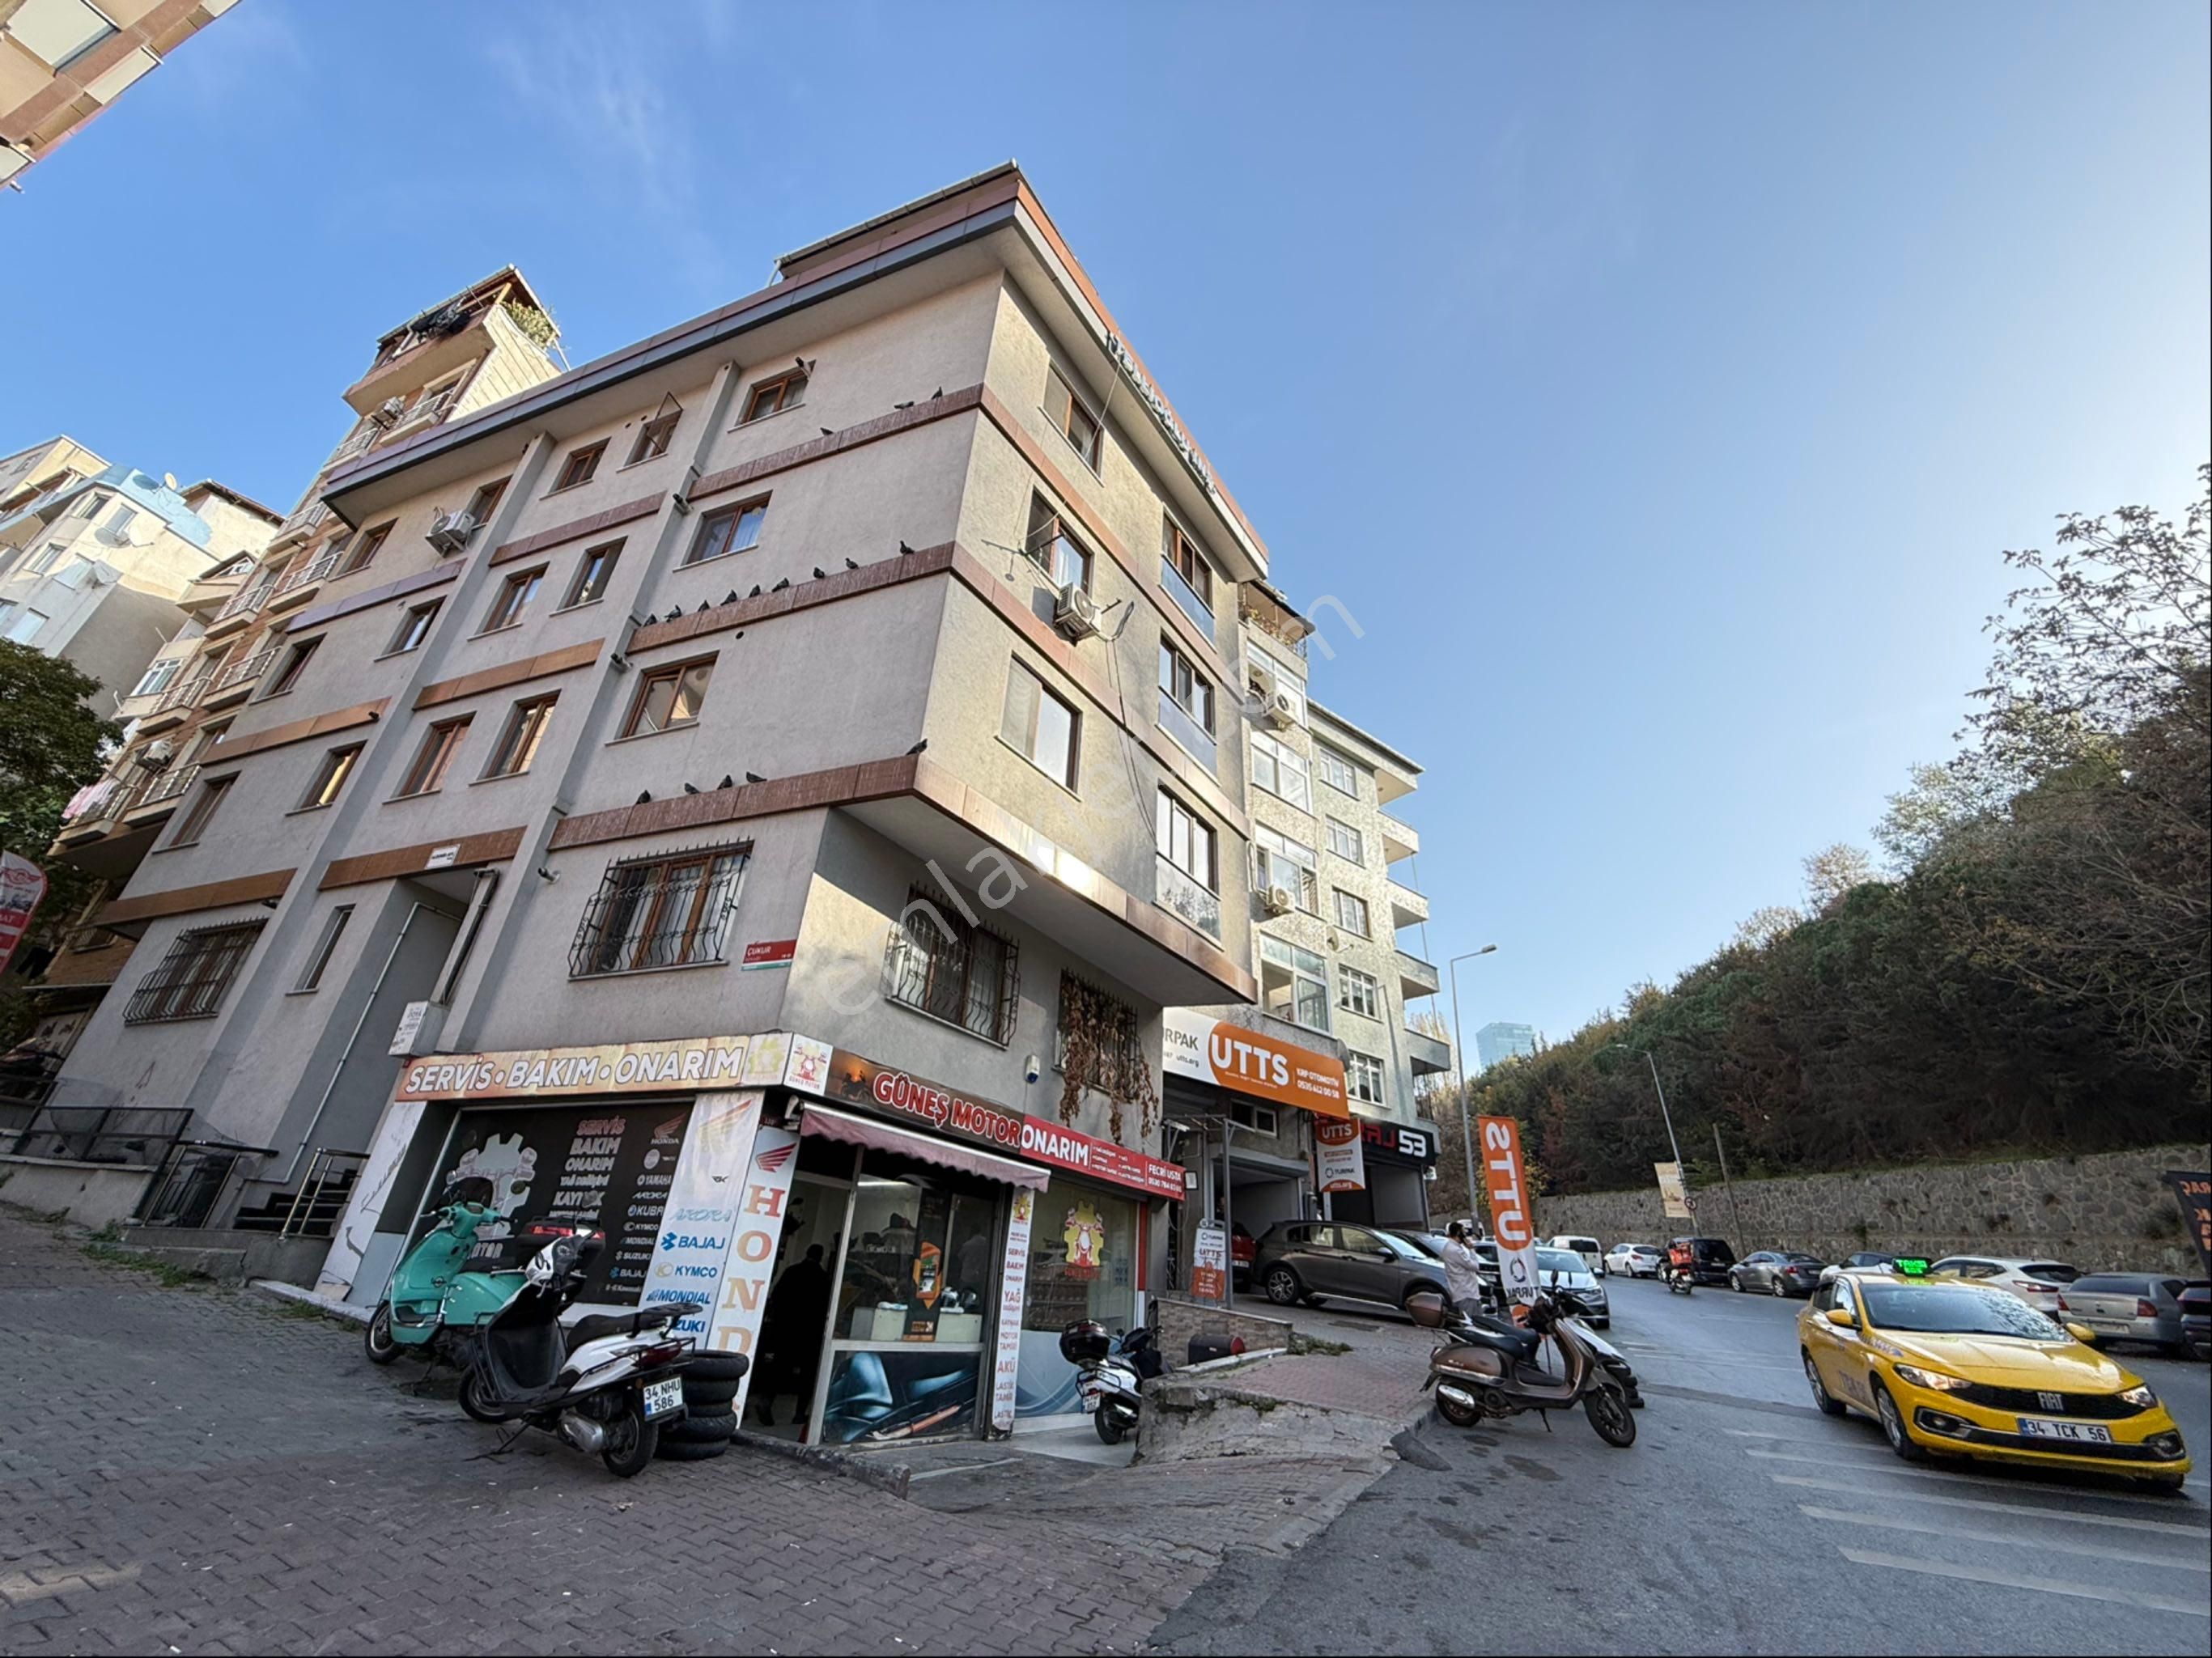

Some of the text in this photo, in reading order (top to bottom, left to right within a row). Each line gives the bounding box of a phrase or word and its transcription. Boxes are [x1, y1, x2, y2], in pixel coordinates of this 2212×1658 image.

[1164, 1028, 1199, 1050] RPAK
[1212, 1034, 1289, 1086] UTTS
[405, 1047, 743, 1093] SERVİS BAKIM ONARIM
[874, 1072, 1021, 1147] GÜNEŞ MOTOR
[1322, 1124, 1352, 1139] UTTS
[569, 1137, 622, 1155] BAKIM
[1021, 1125, 1089, 1165] ONARIM
[1399, 1130, 1426, 1157] 53
[565, 1157, 615, 1171] ONARIM
[553, 1191, 605, 1206] KAYK
[678, 1236, 726, 1250] BAJAJ
[675, 1266, 718, 1278] KYMCO
[716, 1184, 786, 1355] HOND
[1006, 1261, 1024, 1270] BAKIM
[657, 1290, 711, 1304] MONDIAL
[1004, 1288, 1021, 1304] YAĞ
[671, 1319, 706, 1333] ZUKI
[997, 1357, 1016, 1373] AKÜ
[645, 1379, 680, 1400] 34 NHU
[654, 1395, 673, 1411] 586
[2037, 1392, 2063, 1410] FIAT
[2027, 1421, 2106, 1441] 34 TCK 56
